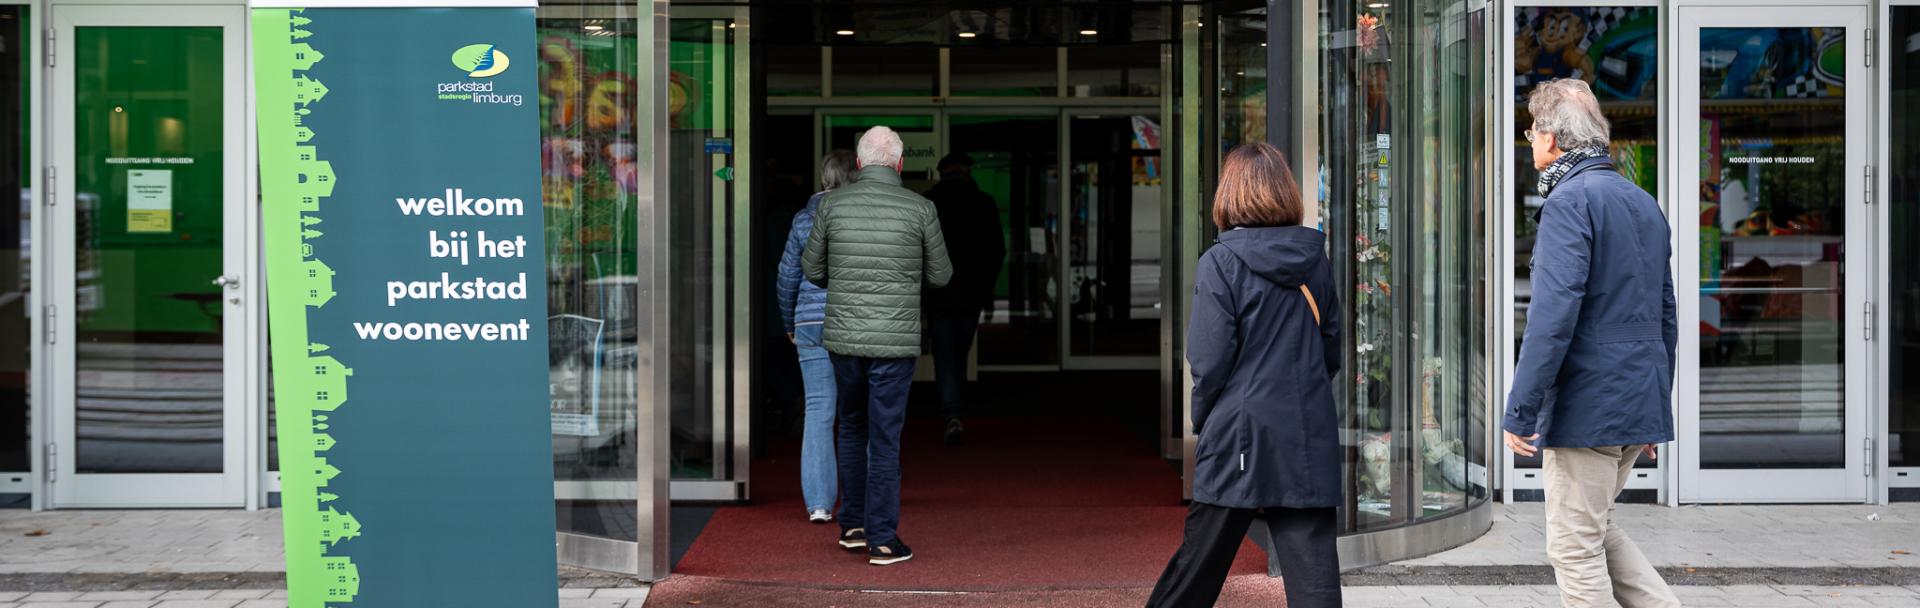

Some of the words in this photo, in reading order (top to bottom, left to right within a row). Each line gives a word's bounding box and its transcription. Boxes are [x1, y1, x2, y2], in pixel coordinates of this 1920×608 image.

[438, 81, 493, 94] parkstad
[473, 92, 522, 106] limburg
[396, 188, 524, 216] welkom
[429, 230, 469, 265] bij
[478, 230, 527, 258] het
[387, 272, 527, 306] parkstad
[353, 318, 530, 341] woonevent
